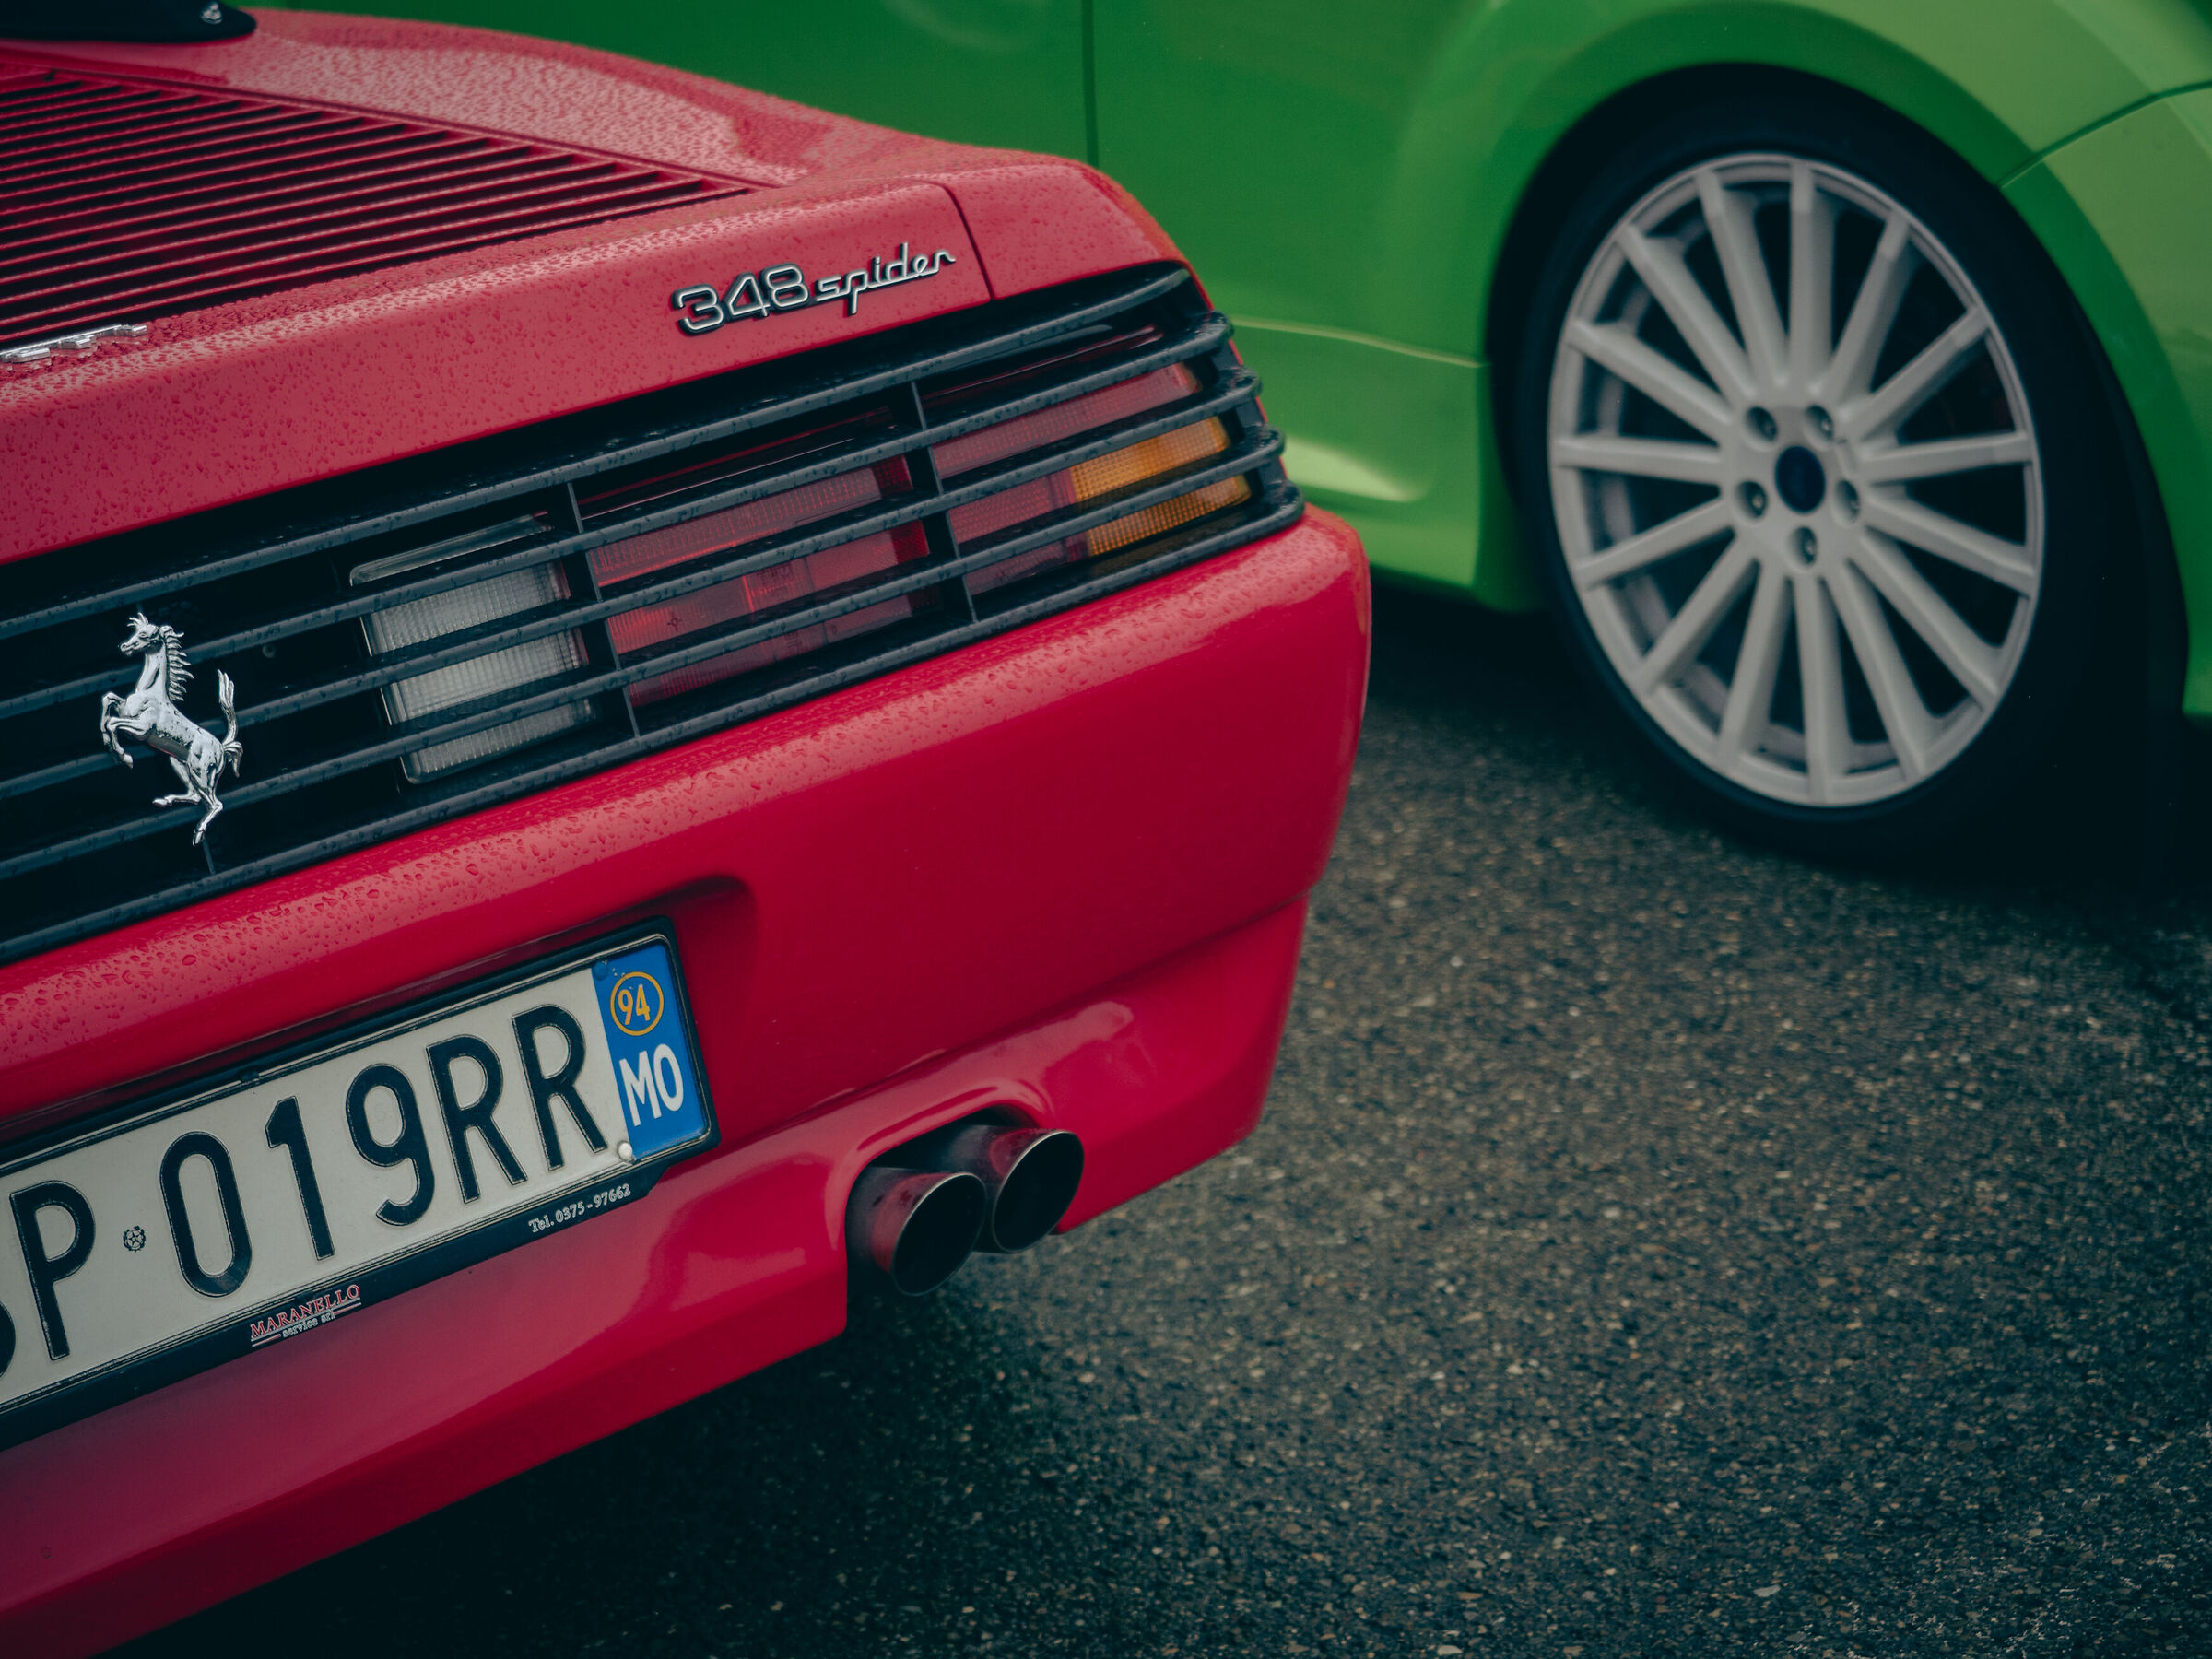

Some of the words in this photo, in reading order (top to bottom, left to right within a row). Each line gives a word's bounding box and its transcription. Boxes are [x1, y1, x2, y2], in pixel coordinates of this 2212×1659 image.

[671, 262, 811, 336] 348
[813, 241, 957, 316] spider
[618, 983, 651, 1026] 94
[618, 1043, 684, 1127] MO
[0, 1180, 96, 1379] P
[159, 1003, 609, 1299] 019RR
[528, 1214, 555, 1233] Tel.
[250, 1284, 360, 1339] MARANELLO
[282, 1317, 319, 1338] service
